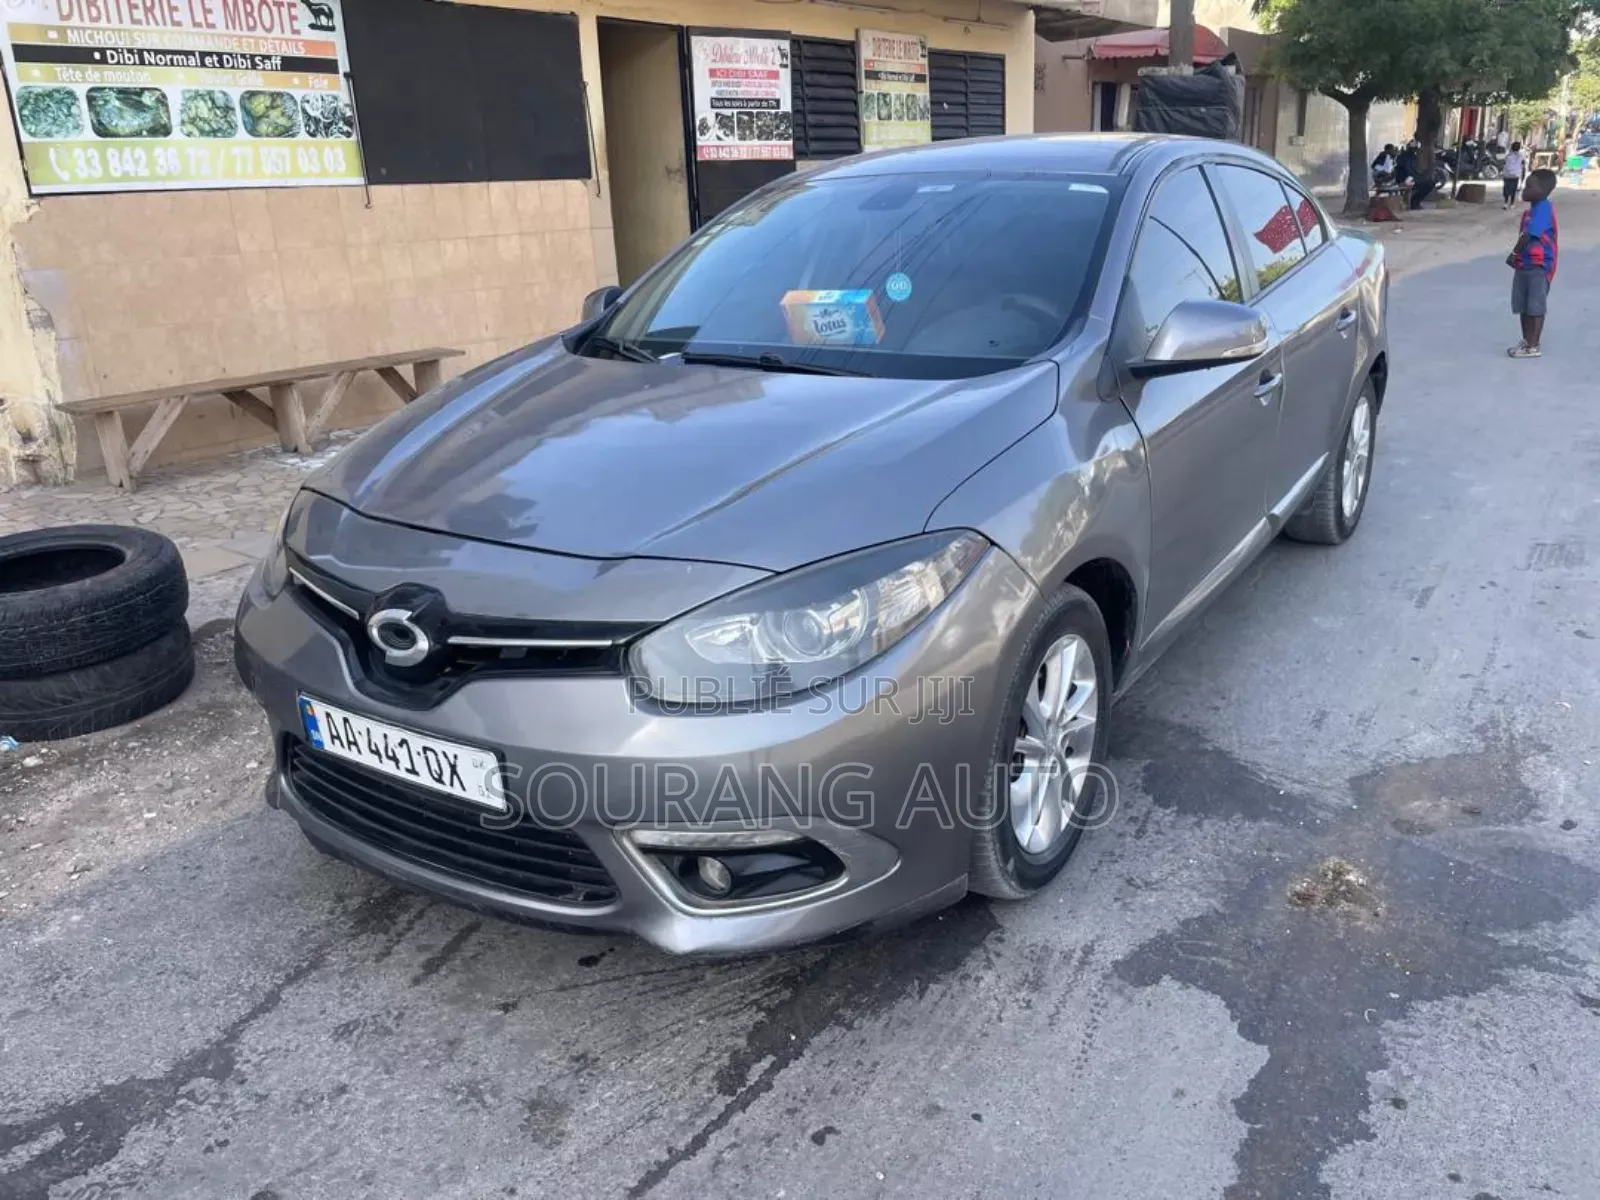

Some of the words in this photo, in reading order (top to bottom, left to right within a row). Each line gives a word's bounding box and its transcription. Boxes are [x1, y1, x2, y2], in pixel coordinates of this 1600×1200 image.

[188, 0, 217, 29] LE
[106, 49, 140, 65] Dibi
[144, 51, 201, 68] Normal
[204, 55, 220, 68] et
[223, 53, 250, 69] Dibi
[255, 54, 282, 71] Saff
[87, 68, 101, 83] de
[73, 147, 103, 178] 33
